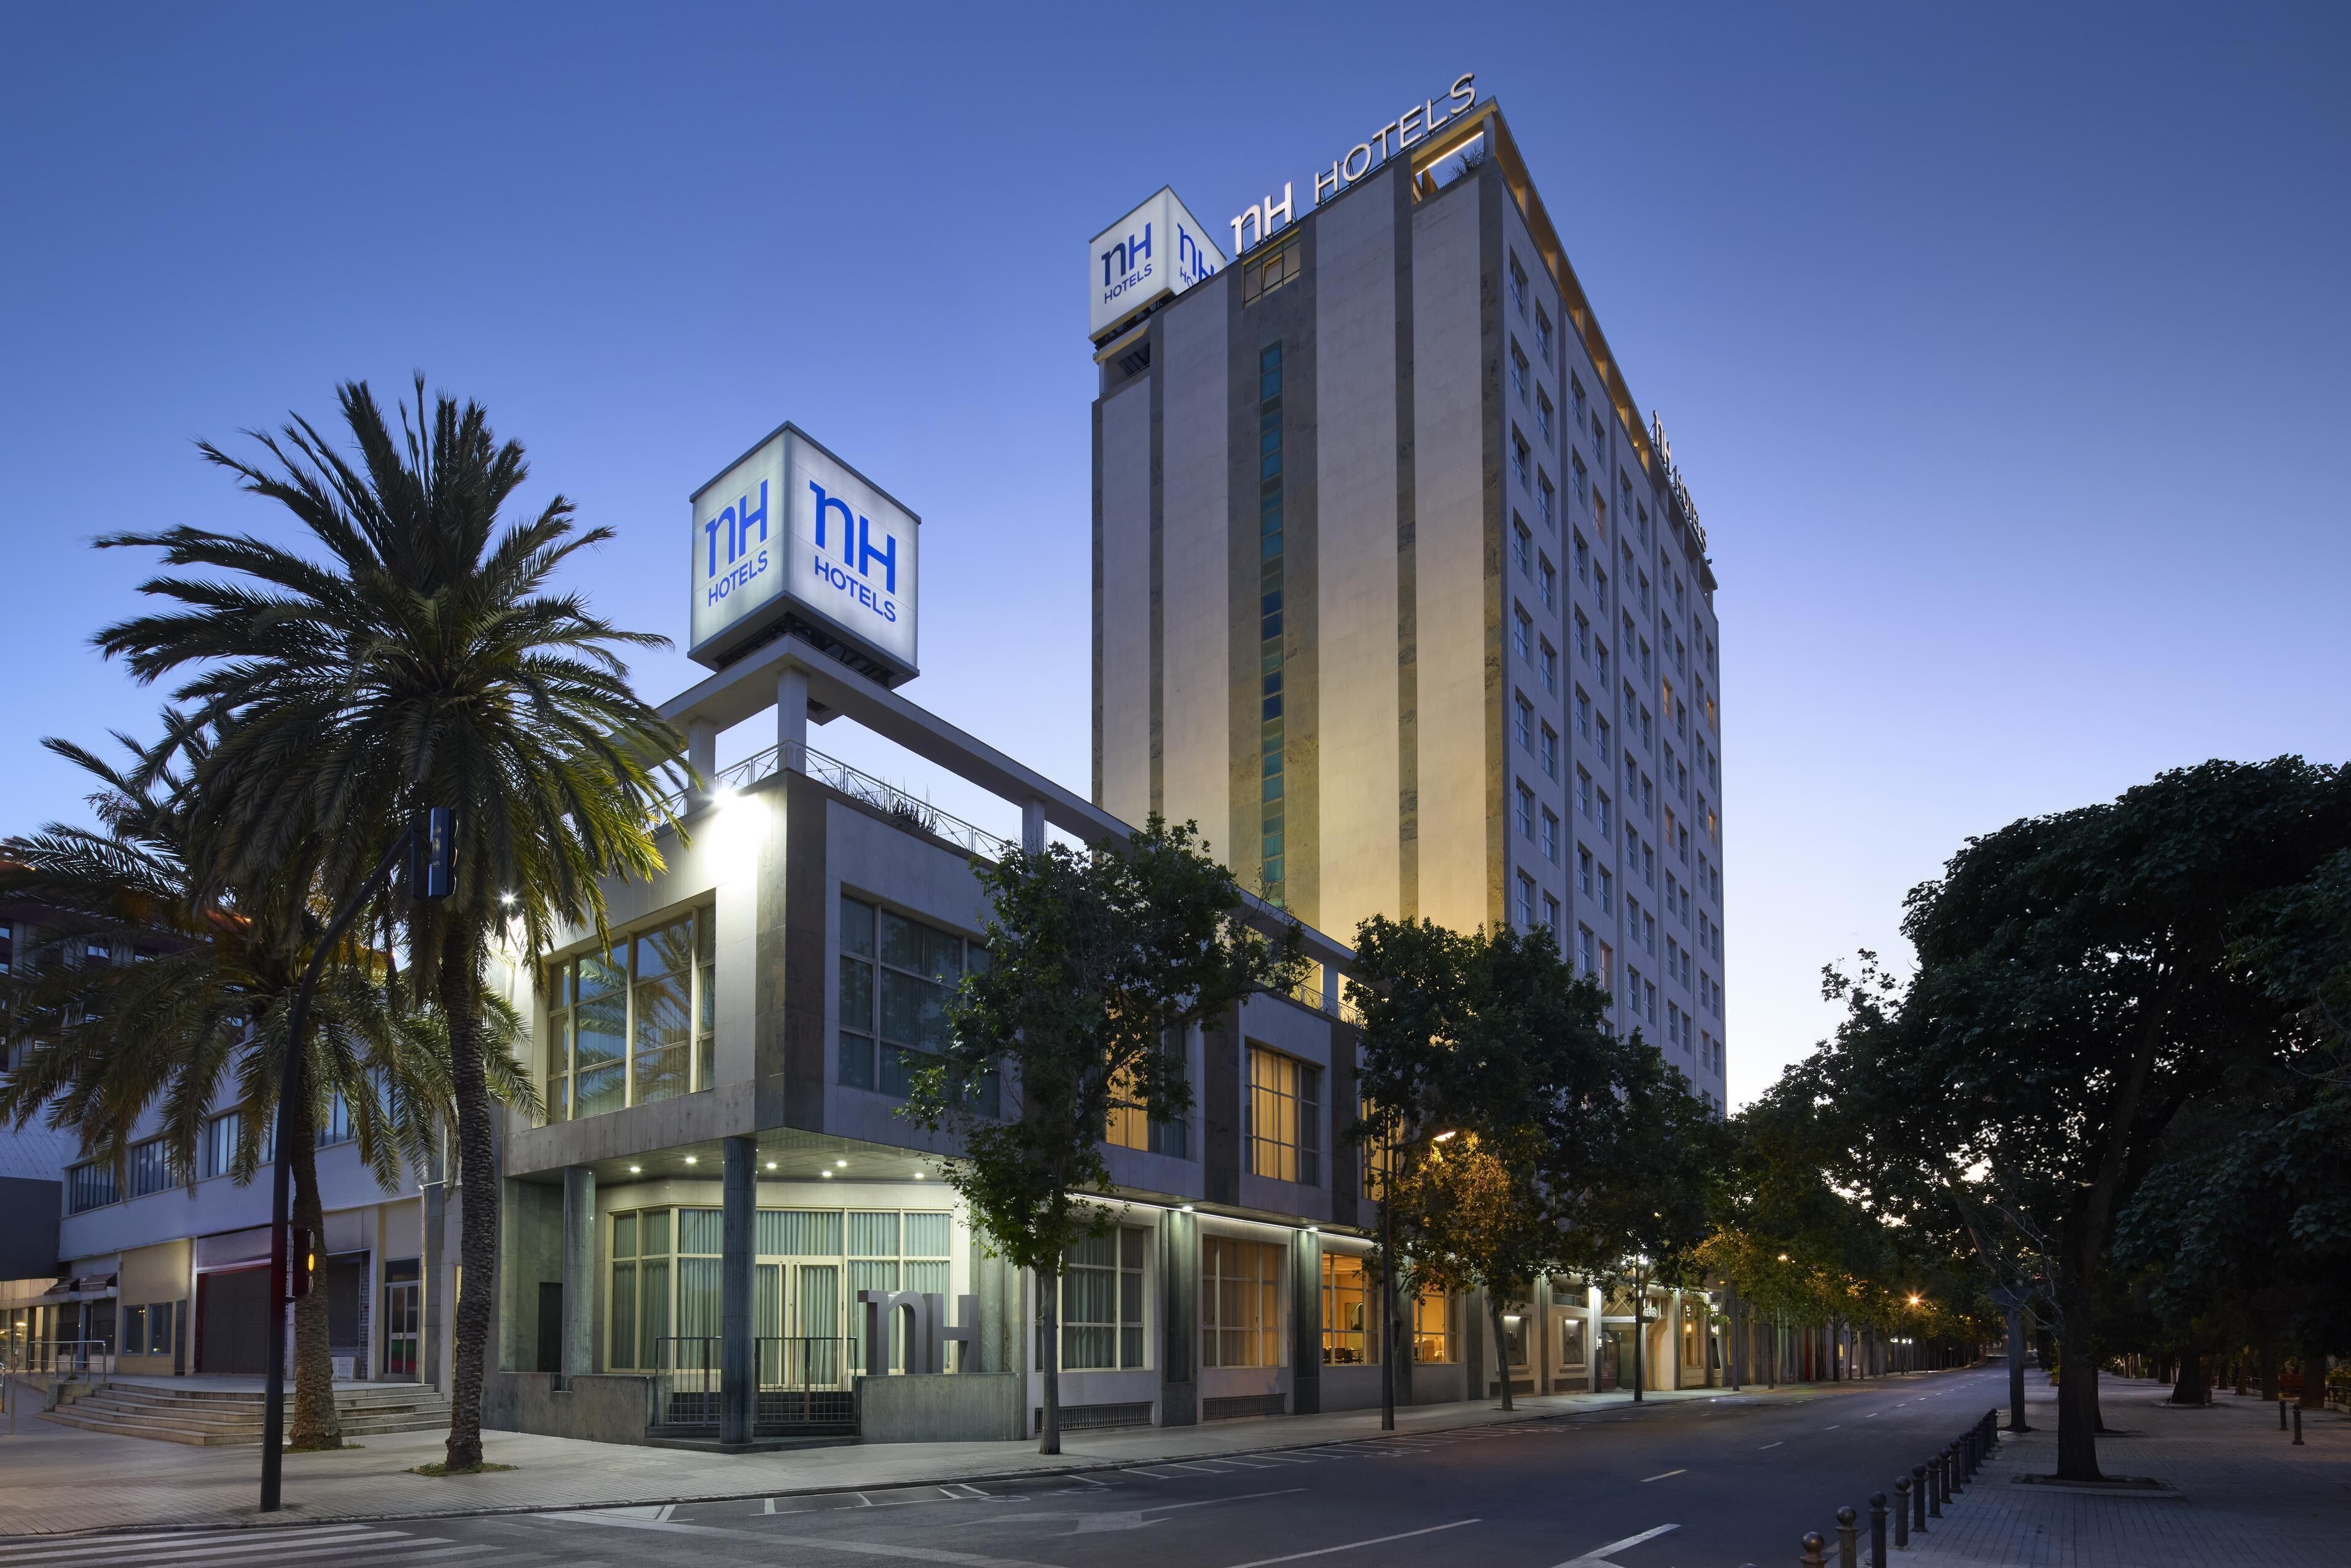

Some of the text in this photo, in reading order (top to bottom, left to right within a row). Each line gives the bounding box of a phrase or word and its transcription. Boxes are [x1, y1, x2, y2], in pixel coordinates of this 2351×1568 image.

[1314, 73, 1475, 206] HOTELS
[1105, 263, 1152, 304] HOTELS
[1673, 465, 1706, 552] HOTELS
[708, 550, 767, 607] HOTELS
[815, 555, 896, 622] HOTELS
